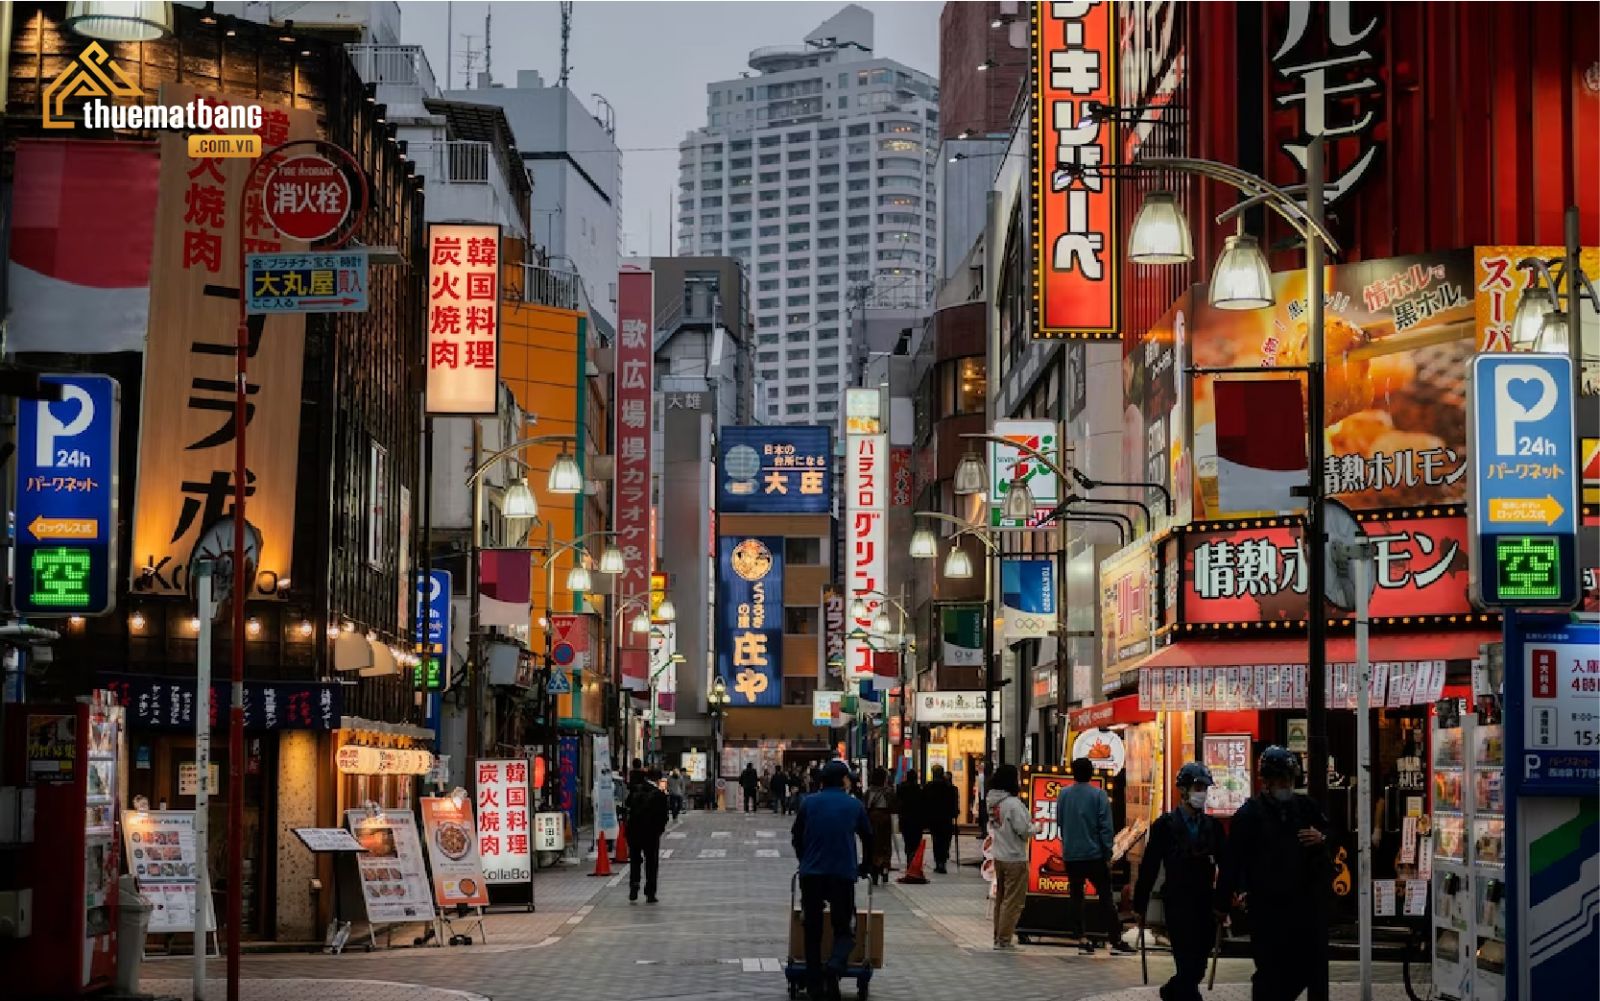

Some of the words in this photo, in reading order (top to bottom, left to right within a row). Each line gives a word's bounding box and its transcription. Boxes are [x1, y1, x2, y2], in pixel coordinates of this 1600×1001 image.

[273, 181, 342, 215] 消火栓
[255, 270, 334, 297] 大丸屋
[431, 237, 462, 370] 炭火焼肉
[465, 237, 497, 370] 韓国料理
[56, 449, 92, 469] 24h
[764, 443, 796, 456] 日本の
[774, 455, 826, 467] 台所になる
[1518, 436, 1557, 456] 24h
[26, 476, 98, 493] パークネット
[1486, 462, 1566, 480] パークネット
[30, 546, 91, 607] 空
[1194, 532, 1460, 599] 情熱ホモン
[1498, 537, 1558, 596] 空
[733, 631, 769, 703] 庄や
[478, 763, 500, 857] 炭火焼肉
[505, 762, 528, 855] 韓国料理
